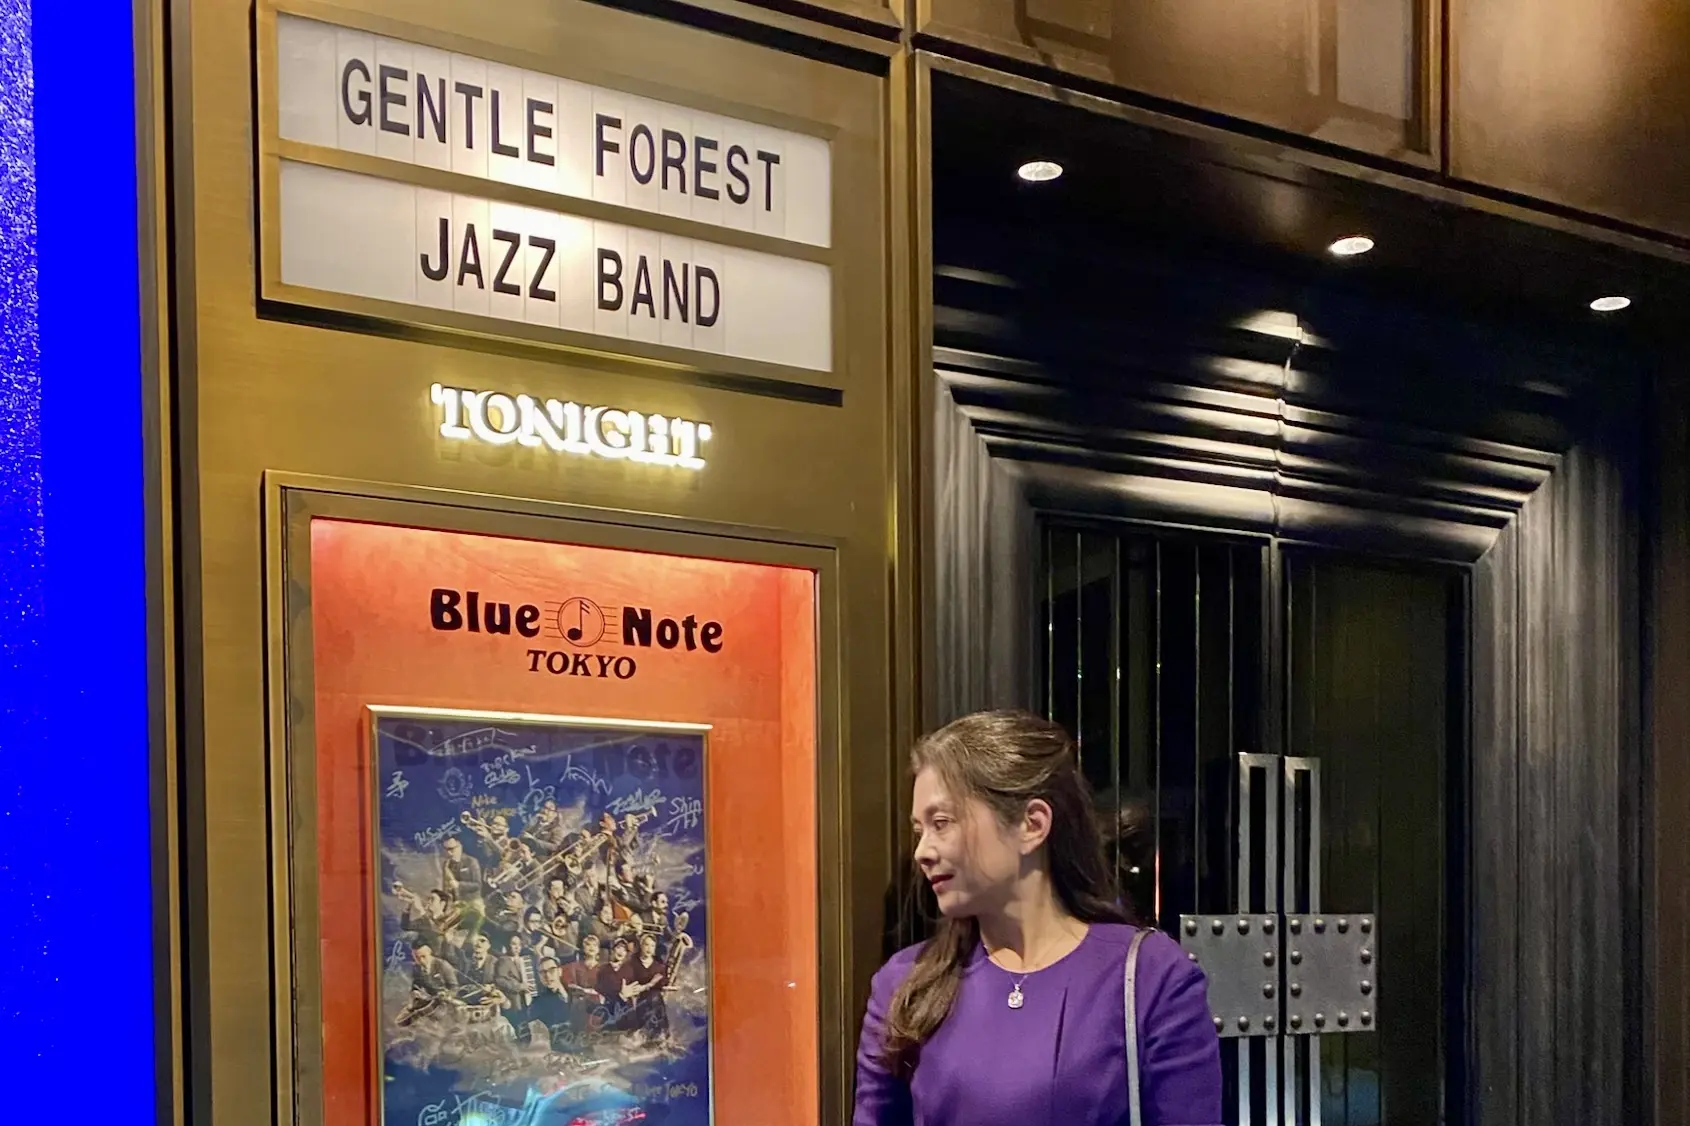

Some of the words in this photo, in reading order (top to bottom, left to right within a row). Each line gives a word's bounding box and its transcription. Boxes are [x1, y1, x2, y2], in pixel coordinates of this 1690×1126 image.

[341, 58, 555, 167] GENTLE
[595, 113, 780, 212] FOREST
[420, 217, 556, 303] JAZZ
[597, 248, 720, 328] BAND
[431, 383, 712, 470] TONIGHT
[430, 588, 541, 638] Blue
[622, 606, 723, 653] Note
[527, 649, 637, 680] TOKYO
